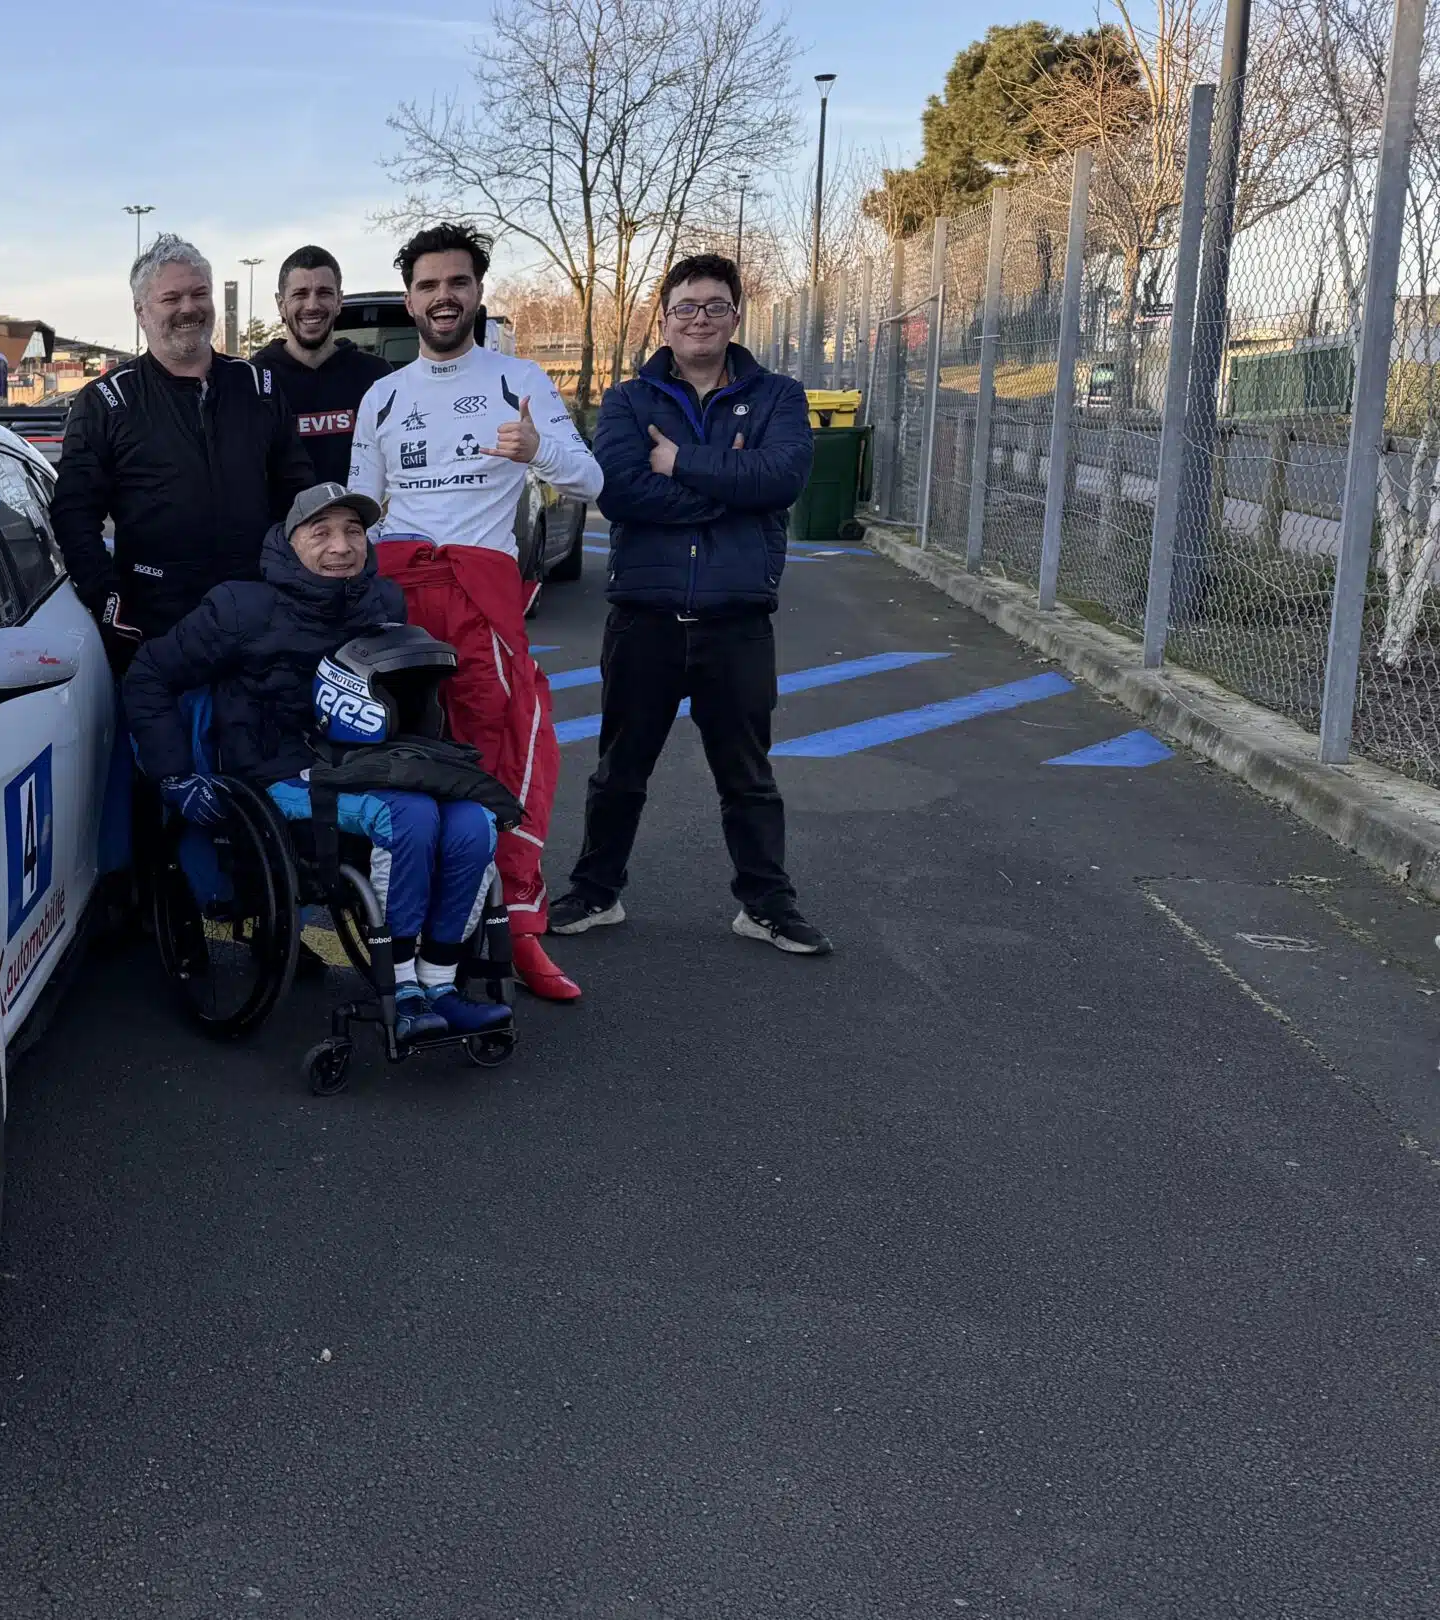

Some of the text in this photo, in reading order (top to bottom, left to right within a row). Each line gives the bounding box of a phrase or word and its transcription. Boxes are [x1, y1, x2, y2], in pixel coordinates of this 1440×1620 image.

[299, 413, 351, 434] EVI'S
[402, 453, 426, 467] GMF
[133, 563, 164, 578] sparco
[327, 669, 366, 693] PROTECT
[316, 683, 386, 733] RRS
[24, 780, 37, 894] 4
